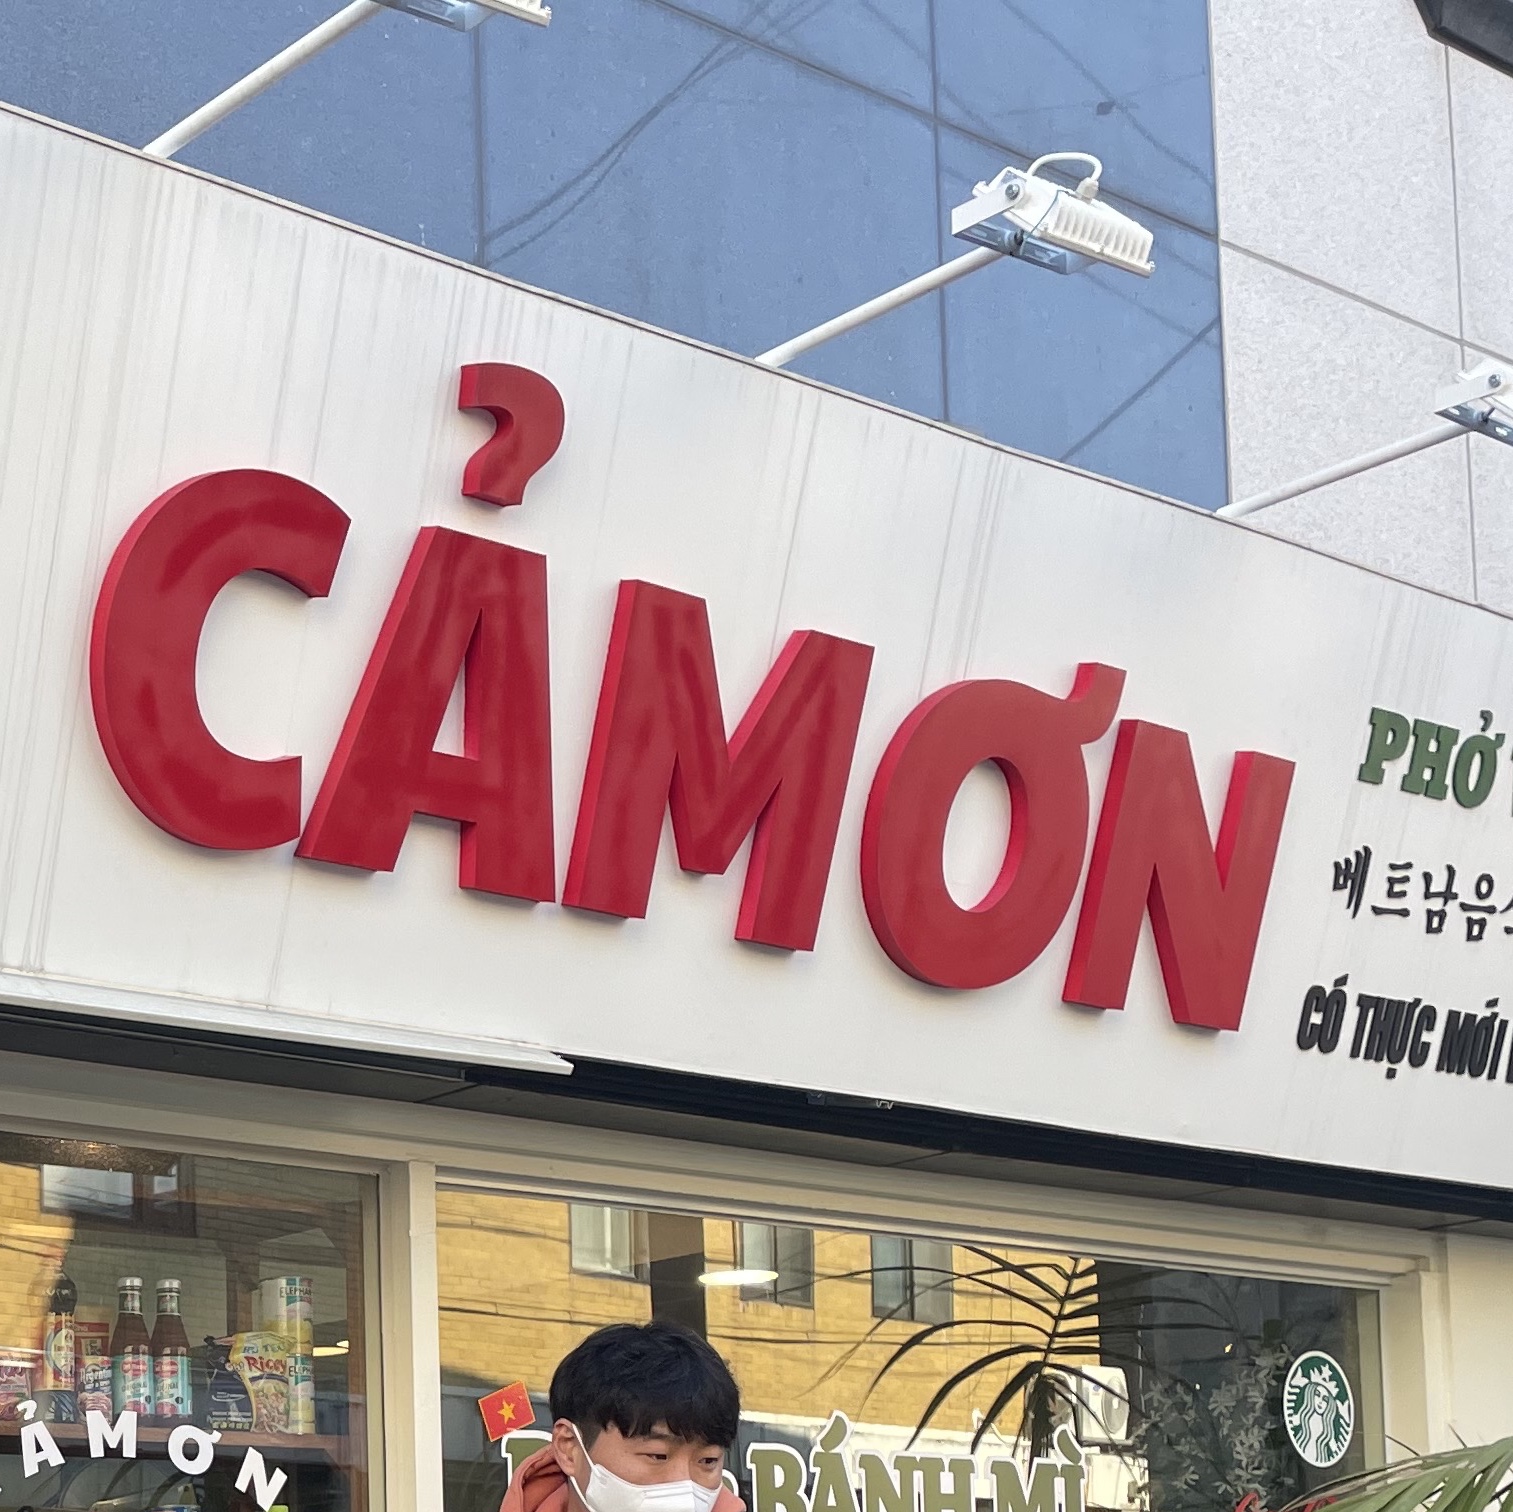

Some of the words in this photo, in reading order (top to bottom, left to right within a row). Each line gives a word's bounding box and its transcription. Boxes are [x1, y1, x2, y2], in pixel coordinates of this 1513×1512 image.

[89, 362, 1296, 1031] CẢMƠN
[1357, 706, 1506, 809] PHỞ
[1296, 973, 1349, 1054] CÓ
[1350, 992, 1437, 1080] THỰC
[1435, 996, 1508, 1081] MỚI
[279, 1286, 313, 1298] ELEPHAN
